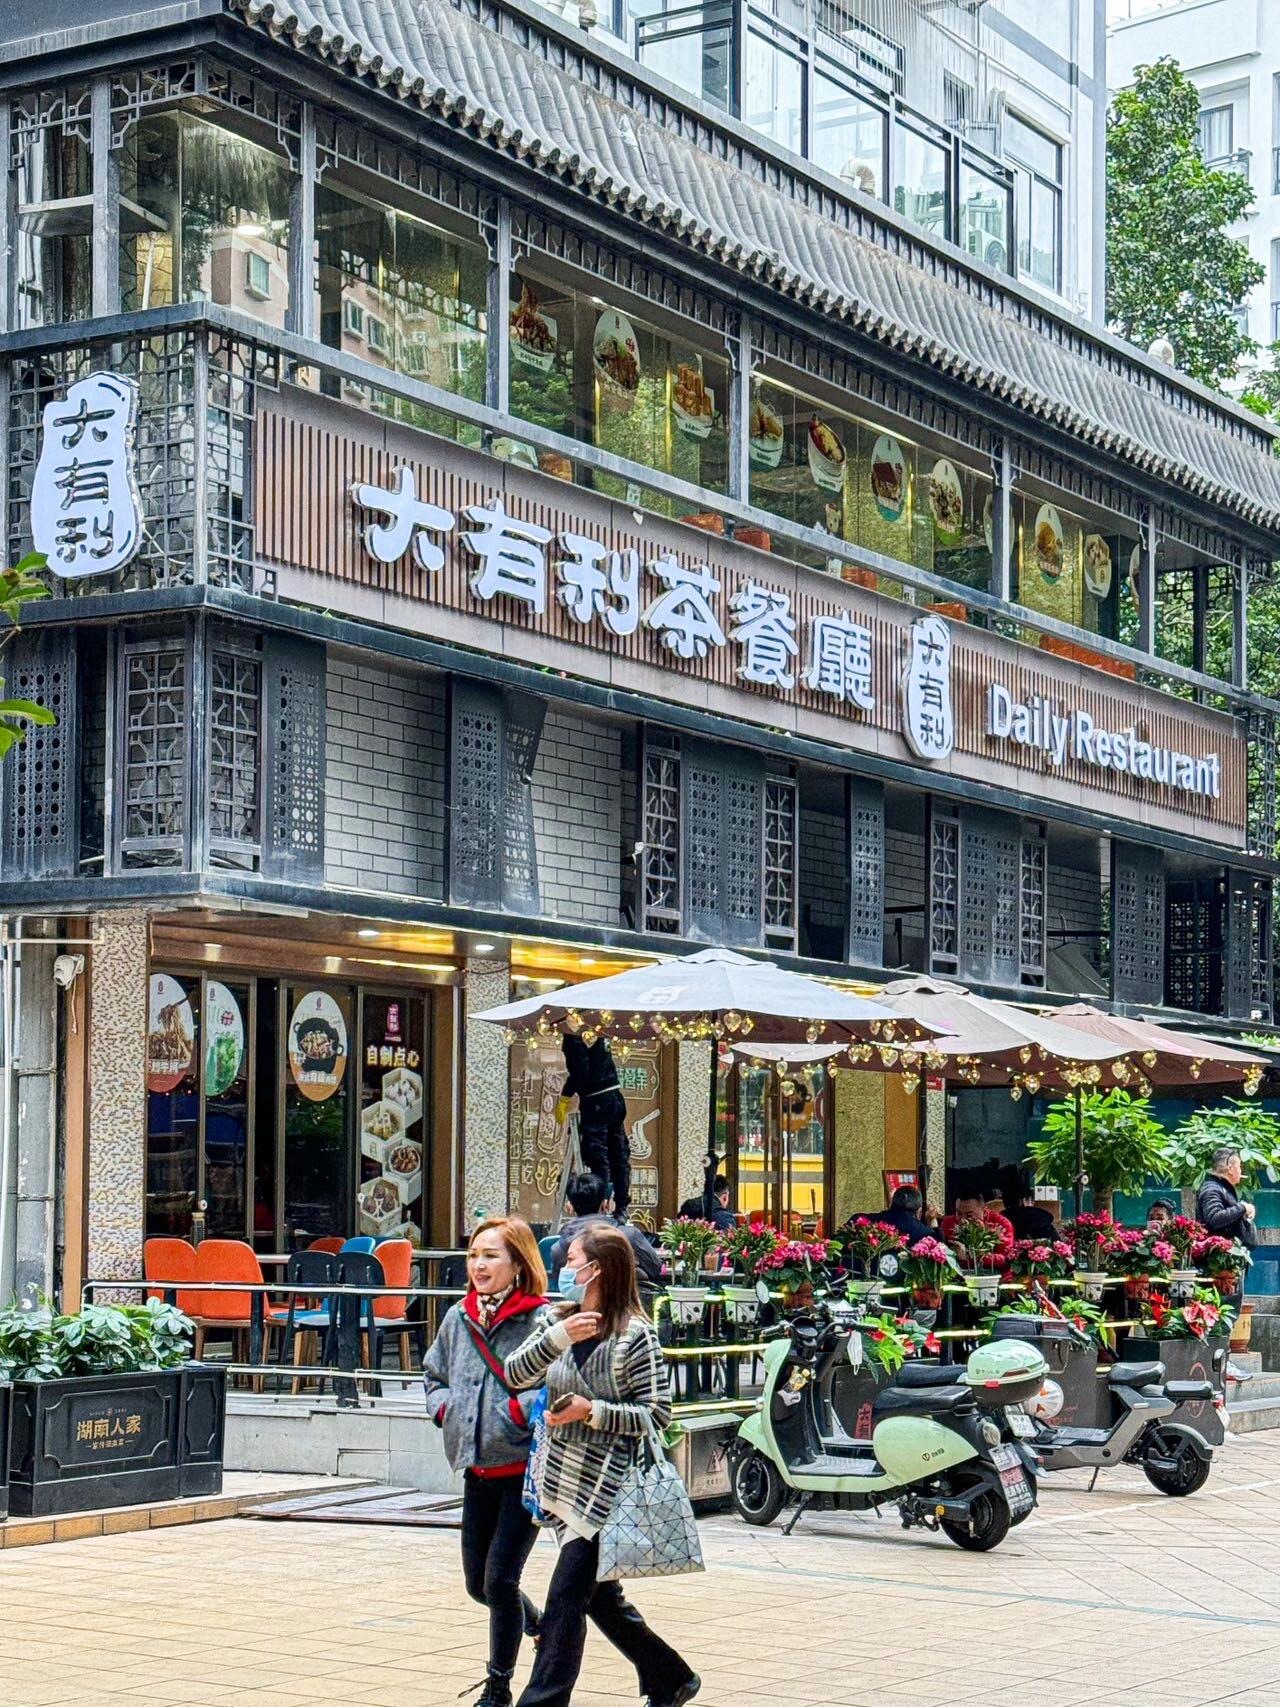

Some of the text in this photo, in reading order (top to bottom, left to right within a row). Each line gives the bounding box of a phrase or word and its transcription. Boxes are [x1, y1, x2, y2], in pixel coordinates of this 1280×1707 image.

[52, 397, 116, 564] 大有利
[349, 466, 877, 710] 大有利茶餐廳
[917, 630, 946, 751] 大有利
[985, 683, 1220, 799] Daily Restaurant
[76, 1414, 142, 1441] 湖南人家
